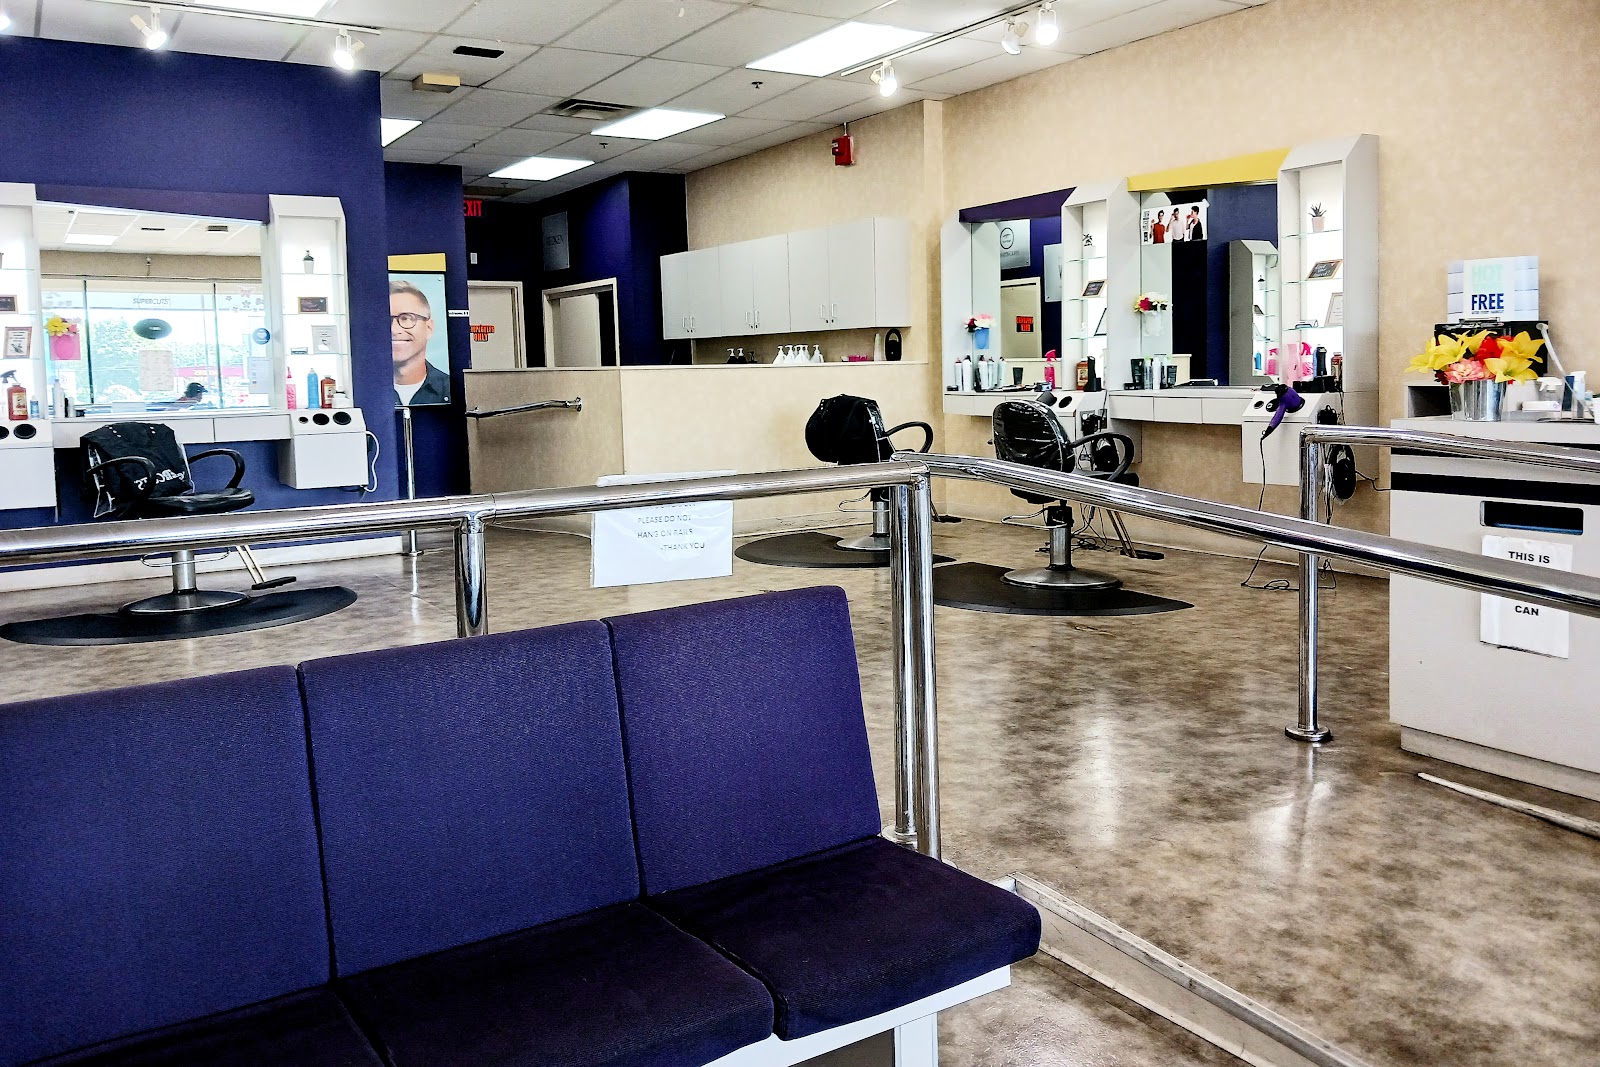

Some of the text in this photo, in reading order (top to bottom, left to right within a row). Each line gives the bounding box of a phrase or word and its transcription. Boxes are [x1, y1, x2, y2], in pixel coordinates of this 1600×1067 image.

[1471, 293, 1504, 310] FREE
[638, 515, 662, 524] PLEASE
[664, 515, 675, 523] DO
[637, 530, 659, 539] HANG
[1508, 551, 1550, 564] THIS IS
[1515, 605, 1539, 616] CAN
